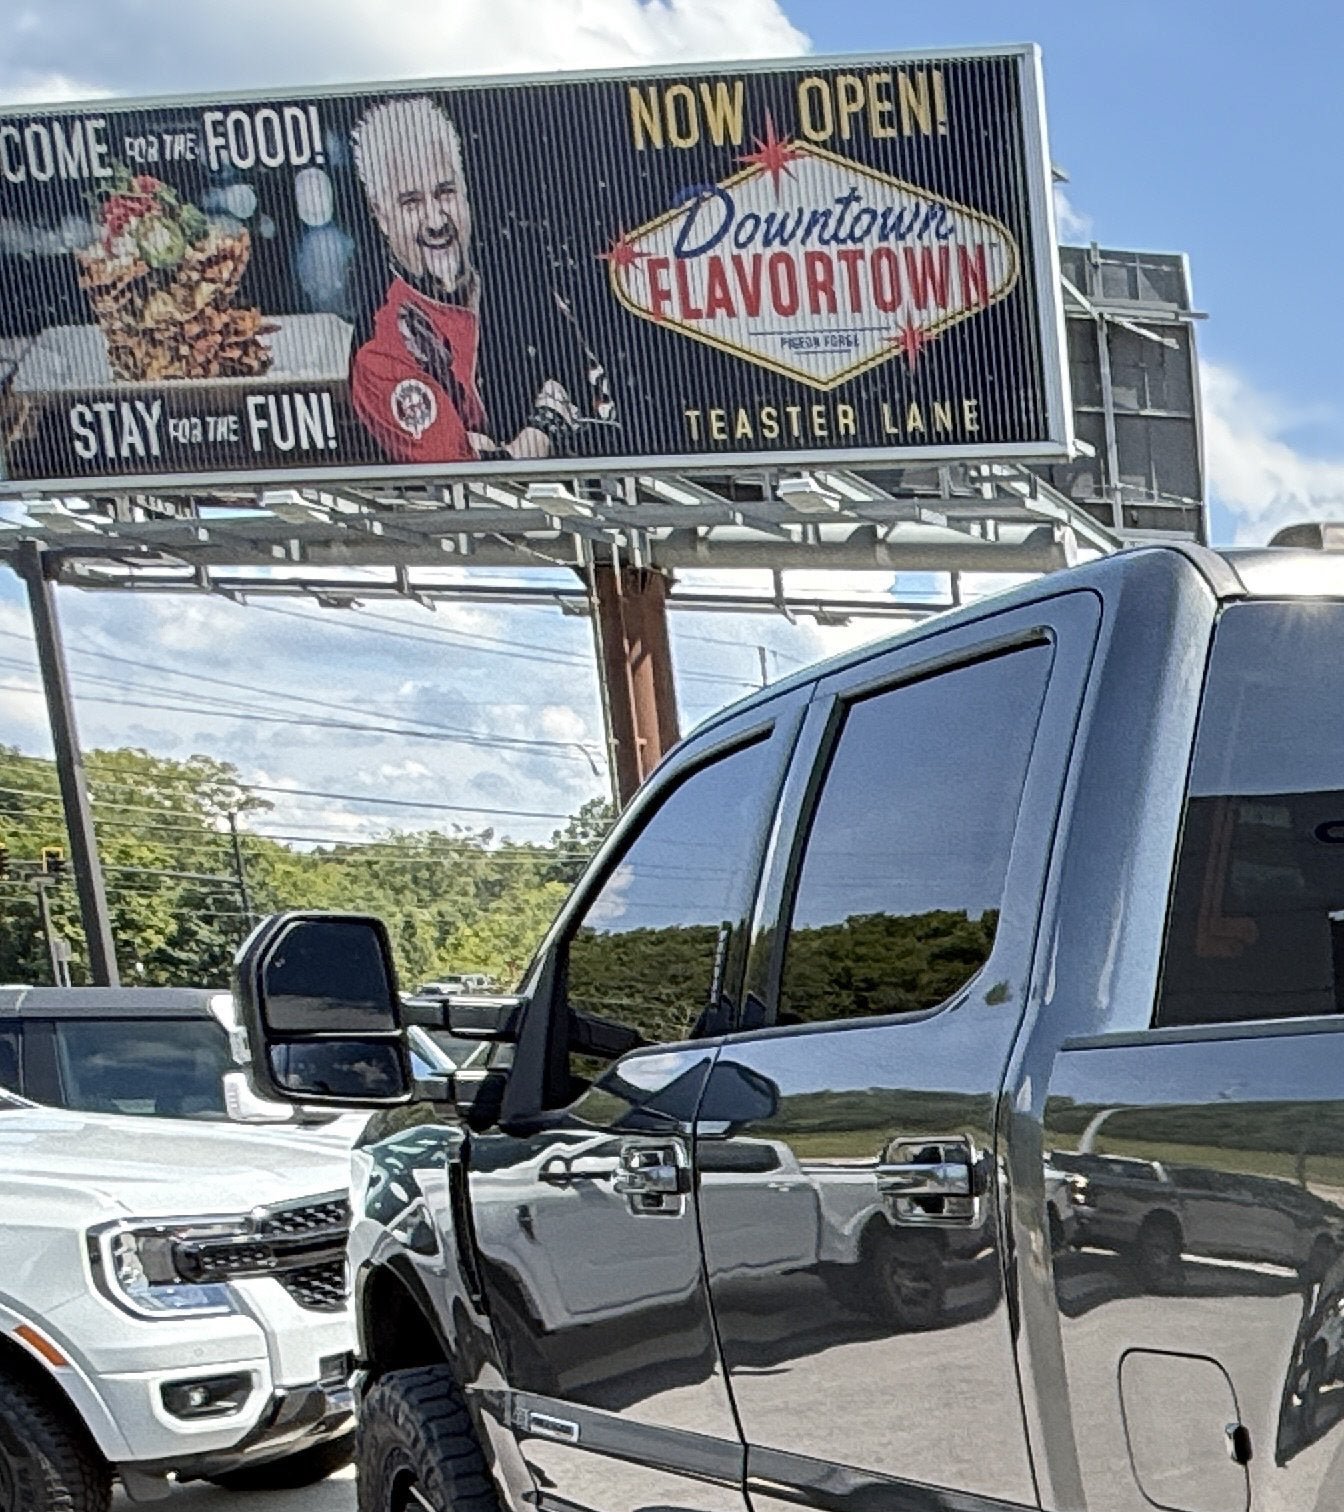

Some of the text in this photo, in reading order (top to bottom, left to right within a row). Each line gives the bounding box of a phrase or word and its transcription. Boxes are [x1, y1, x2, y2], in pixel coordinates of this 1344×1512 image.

[1, 105, 326, 183] COME FOR THE FOOD!
[629, 70, 949, 151] NOW OPEN!
[672, 181, 954, 259] Downtown
[646, 244, 990, 321] FLAVORTOWN
[70, 392, 338, 459] STAY FOR THE FUN!
[685, 399, 981, 441] TEASTER LANE
